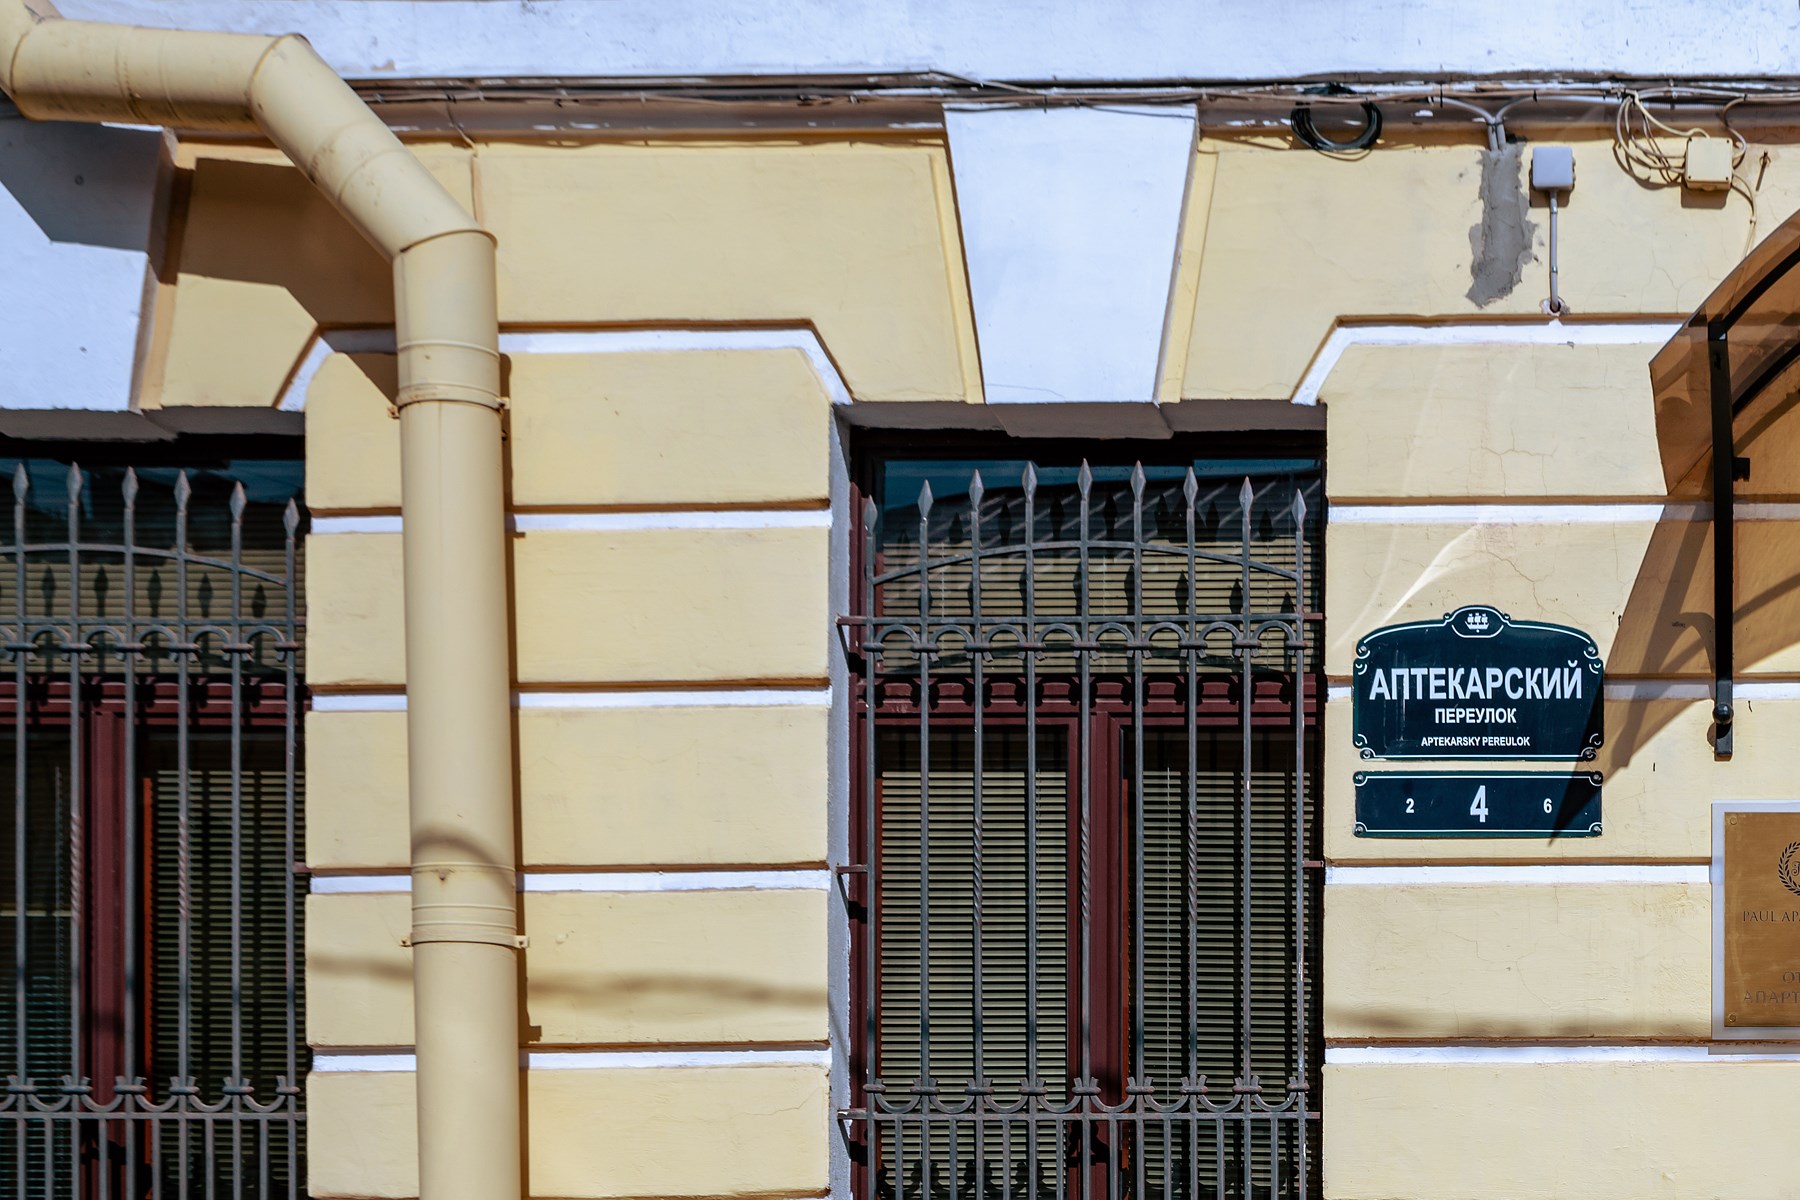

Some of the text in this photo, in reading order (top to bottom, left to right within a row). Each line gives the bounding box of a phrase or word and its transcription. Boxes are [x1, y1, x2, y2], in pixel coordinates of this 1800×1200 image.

[1368, 659, 1583, 700] АПТЕКАРСКИЙ
[1434, 707, 1517, 724] ПЕРЕУЛОК
[1420, 736, 1531, 747] APTEKARSKY PEREULOK
[1405, 784, 1553, 823] 2 4 6
[1743, 910, 1777, 922] PAUL
